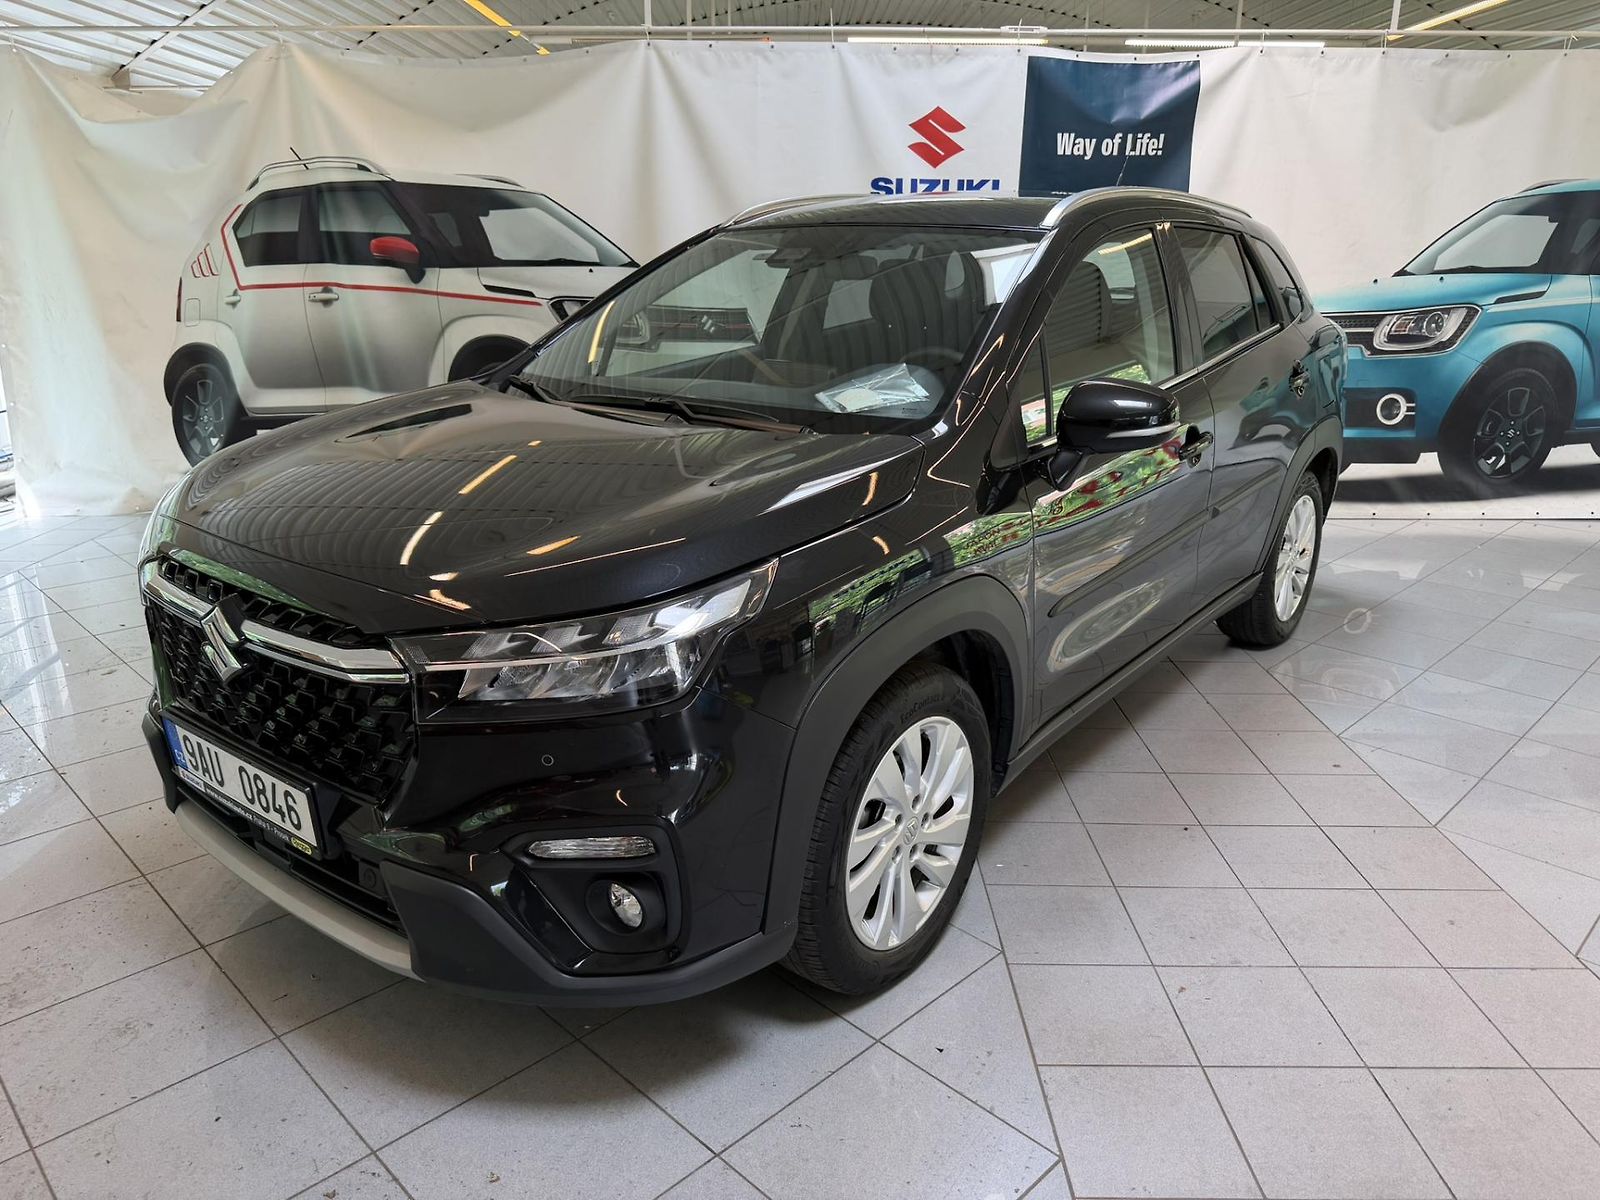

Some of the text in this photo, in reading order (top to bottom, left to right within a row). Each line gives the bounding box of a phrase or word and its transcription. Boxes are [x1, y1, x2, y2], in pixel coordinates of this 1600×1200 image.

[1056, 132, 1165, 160] Way of Life!
[182, 734, 225, 788] 9AU
[238, 765, 302, 831] 0846
